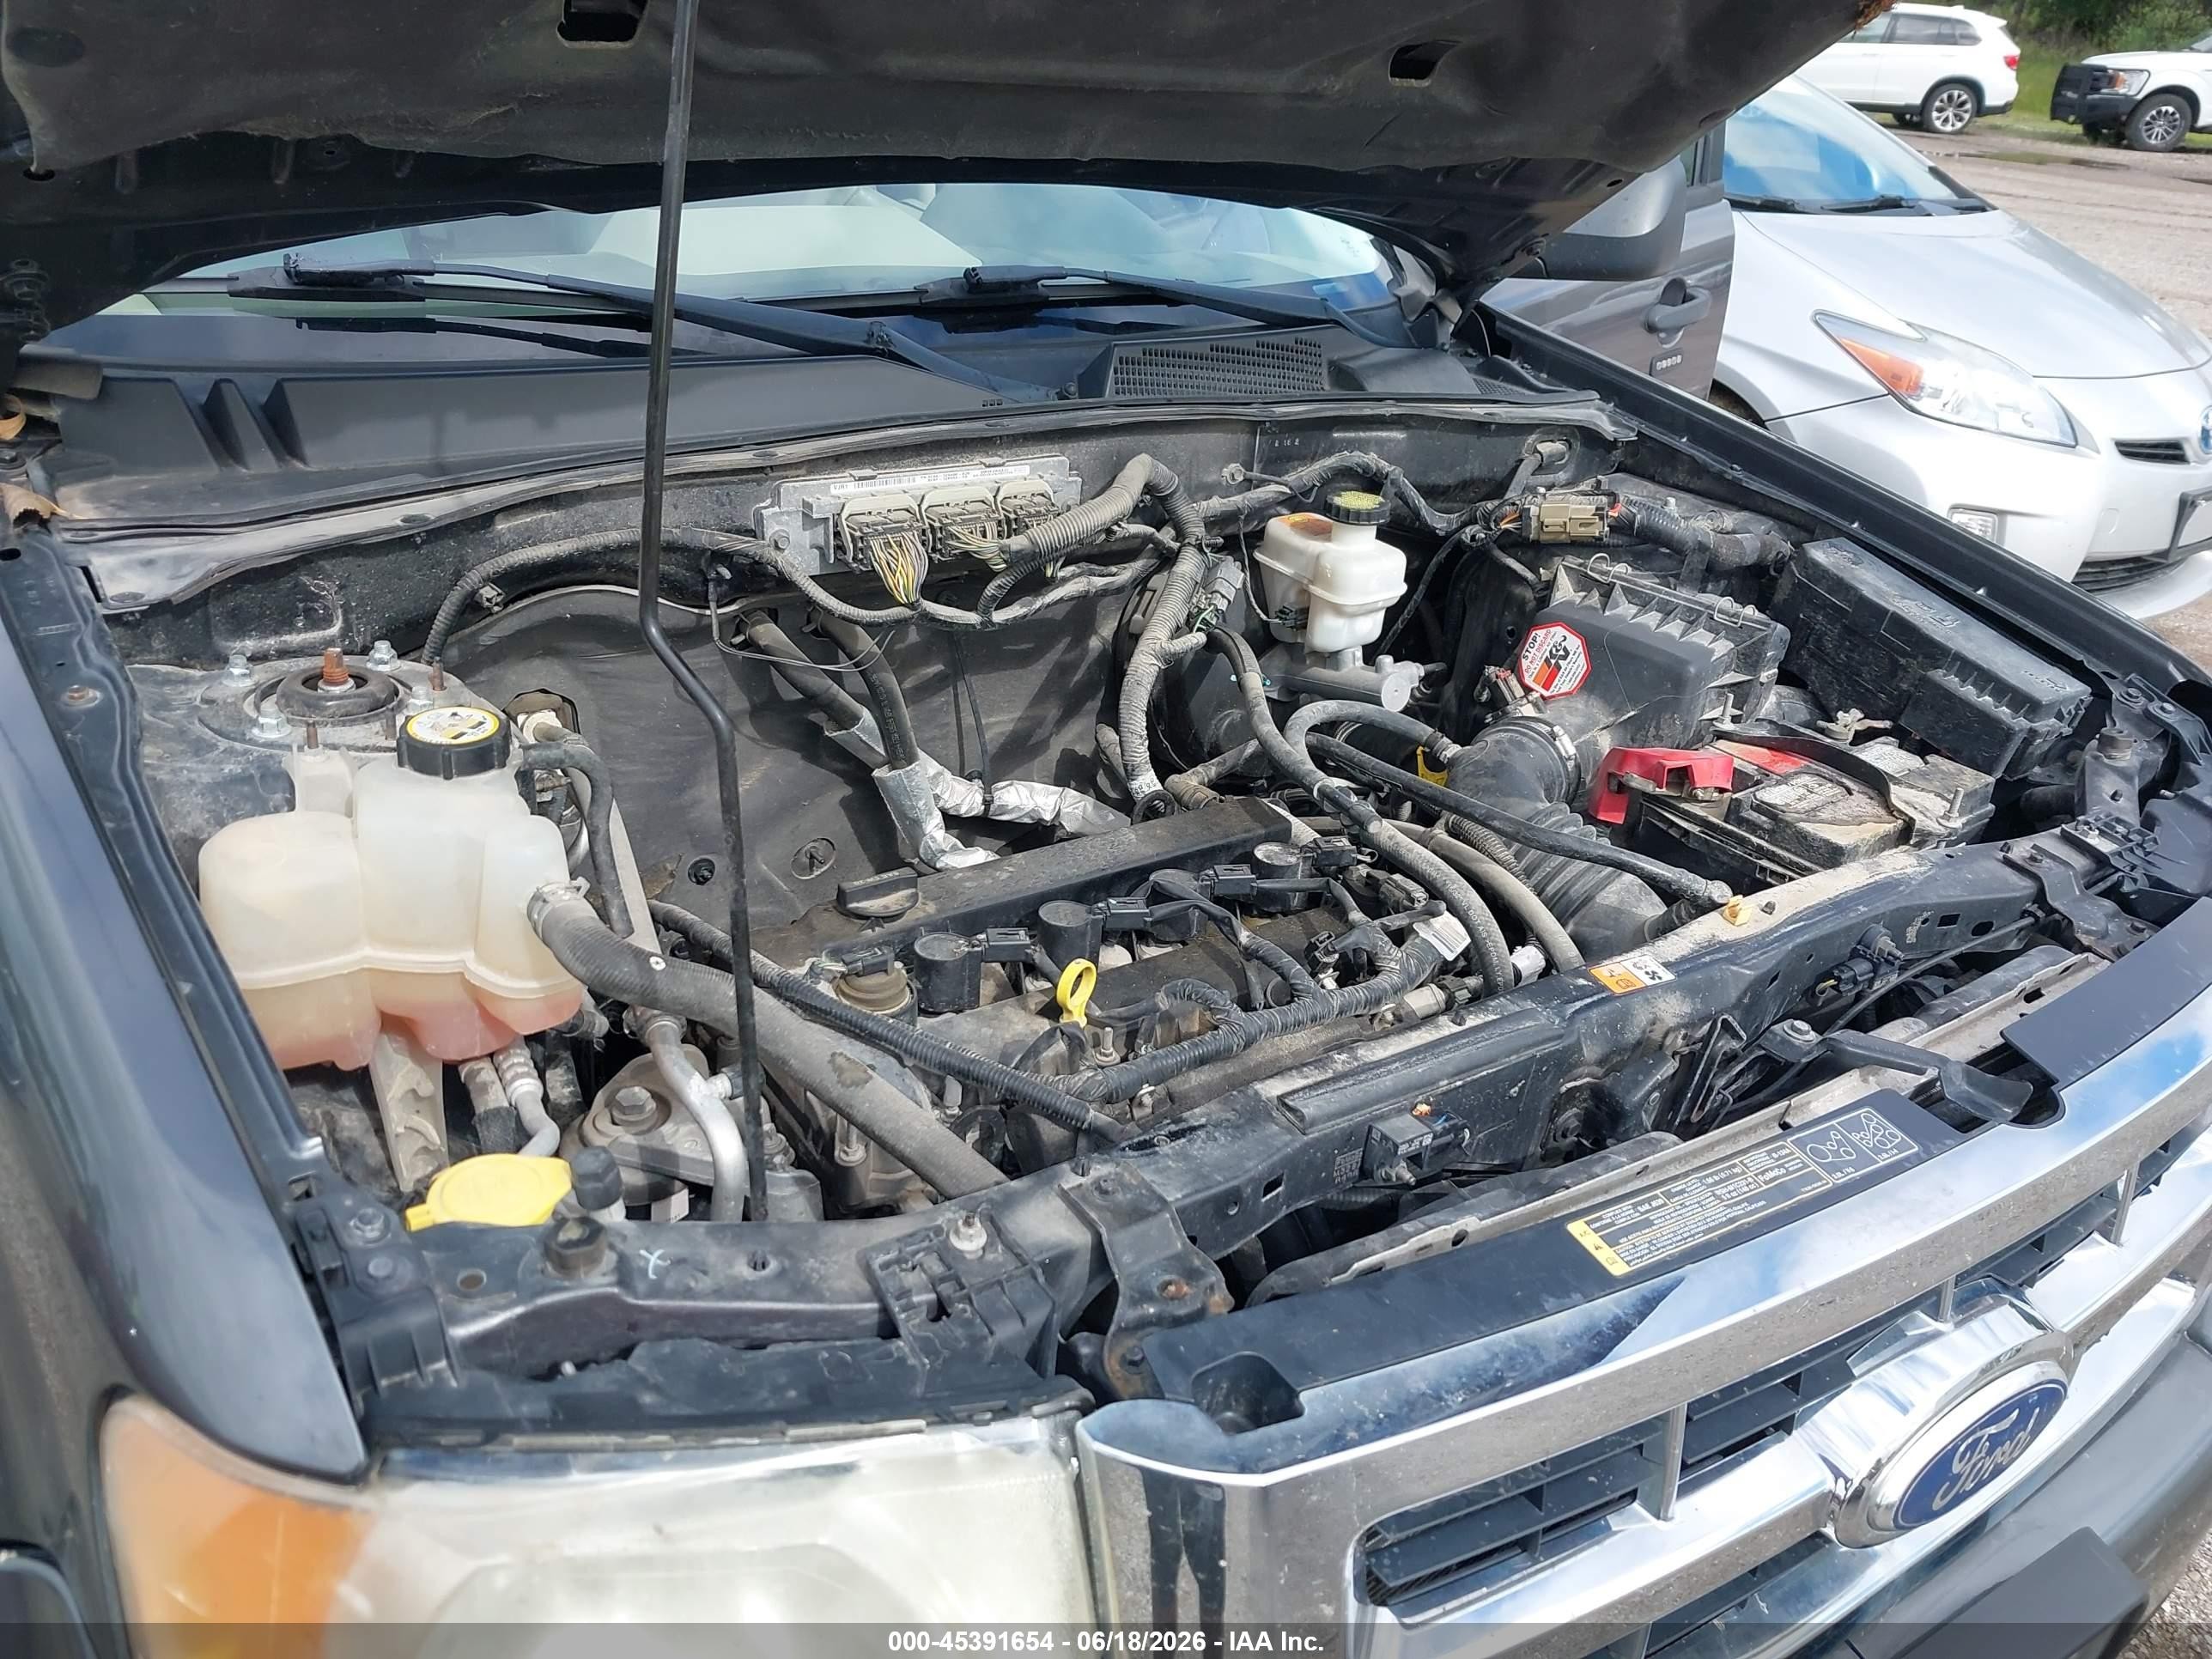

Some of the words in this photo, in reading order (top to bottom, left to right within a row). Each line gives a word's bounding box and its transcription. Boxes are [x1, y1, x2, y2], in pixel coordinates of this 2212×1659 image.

[1522, 632, 1541, 661] STOP!
[1535, 629, 1551, 653] DISCARD
[1466, 908, 1480, 926] DOT
[1931, 1407, 2039, 1510] Ford
